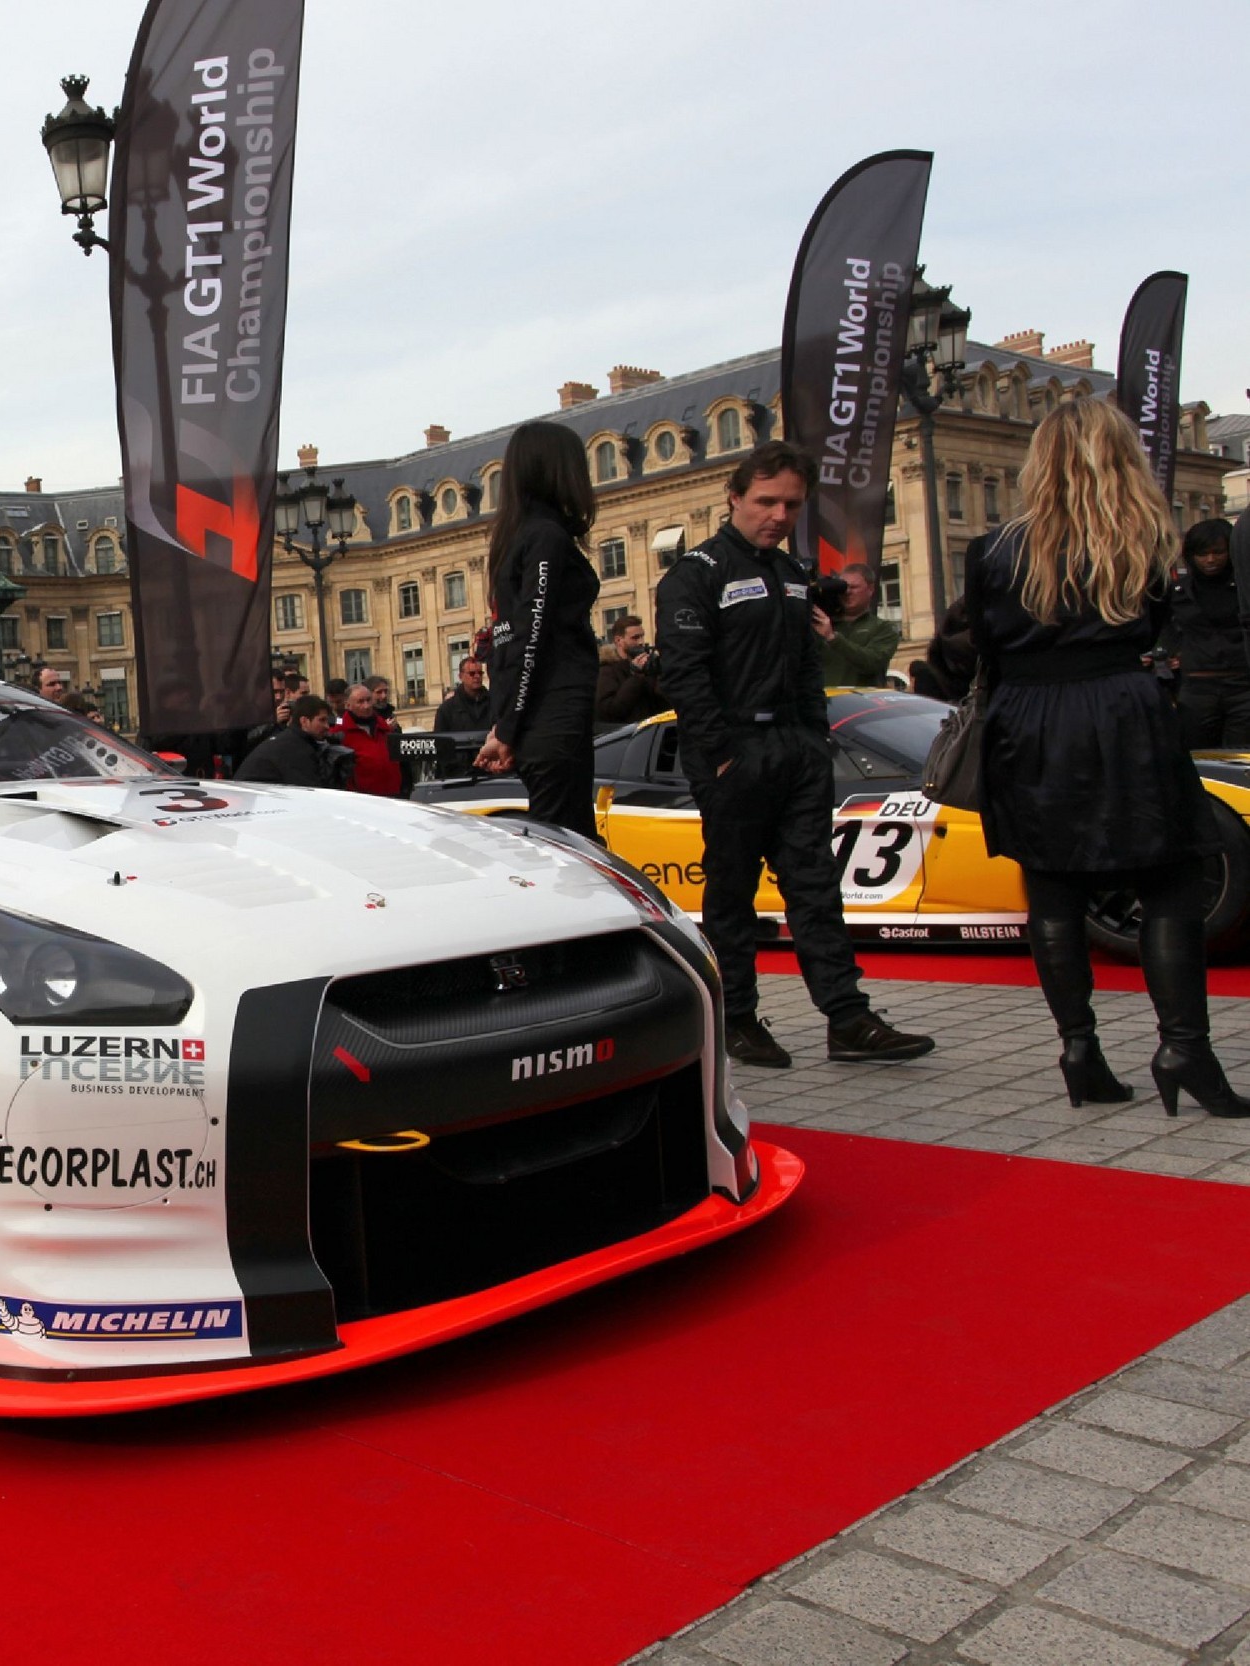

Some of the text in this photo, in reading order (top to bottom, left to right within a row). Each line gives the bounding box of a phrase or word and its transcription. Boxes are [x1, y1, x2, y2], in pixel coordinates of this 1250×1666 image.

[181, 56, 229, 404] FIA GT1 World
[225, 48, 285, 402] Championship
[820, 258, 871, 486] FIA GT1 World
[849, 261, 905, 489] Championship
[1140, 348, 1161, 422] World
[515, 561, 549, 712] www.gt1world.com
[139, 788, 229, 813] 3
[879, 801, 930, 817] DEU
[832, 820, 914, 887] 13
[891, 926, 930, 938] Castrol
[959, 926, 1021, 940] BILSTEIN
[20, 1035, 180, 1060] LUZERN
[70, 1083, 205, 1097] BUSINESS DEVELOPMENT
[52, 1308, 231, 1332] MICHELIN
